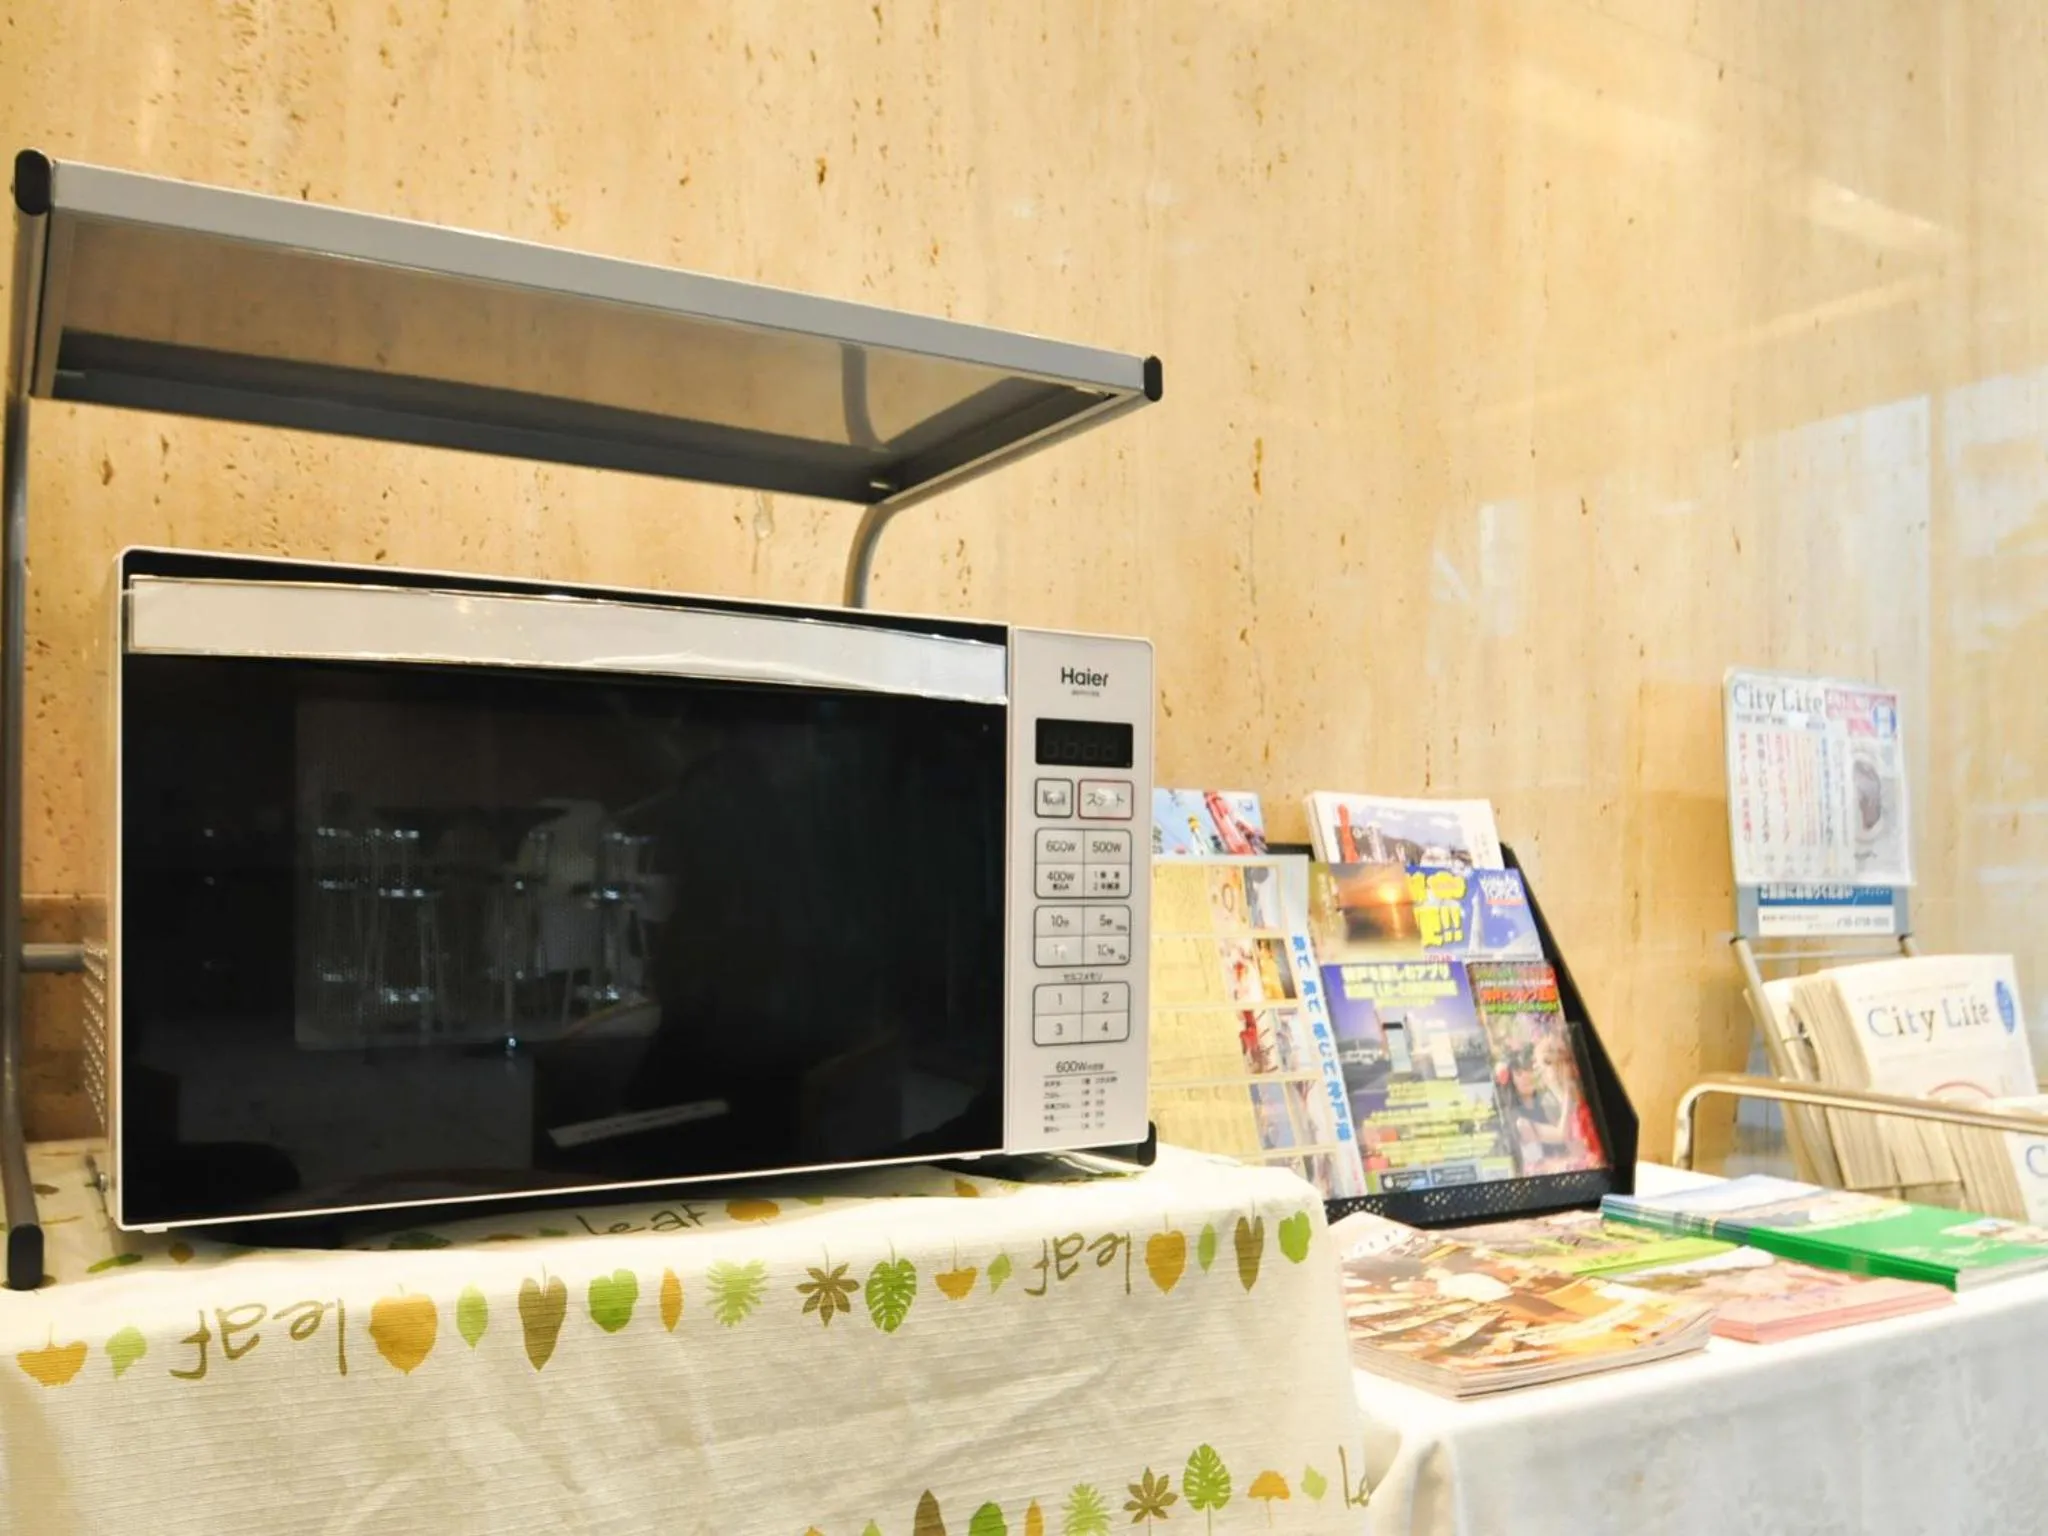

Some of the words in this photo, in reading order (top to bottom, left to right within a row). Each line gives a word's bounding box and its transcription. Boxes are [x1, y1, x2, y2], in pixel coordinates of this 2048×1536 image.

[1060, 667, 1109, 688] Haier
[1733, 684, 1777, 718] City
[1046, 840, 1076, 853] 600W
[1092, 840, 1122, 853] 500W
[1046, 870, 1075, 882] 400W
[1057, 993, 1063, 1005] 1
[1101, 992, 1109, 1004] 2
[1867, 1005, 1936, 1042] City
[1941, 996, 1990, 1028] Life
[1055, 1023, 1063, 1035] 3
[1101, 1021, 1109, 1033] 4
[576, 1202, 708, 1236] leaf
[1023, 1230, 1133, 1296] leaf
[168, 1297, 348, 1380] leaf
